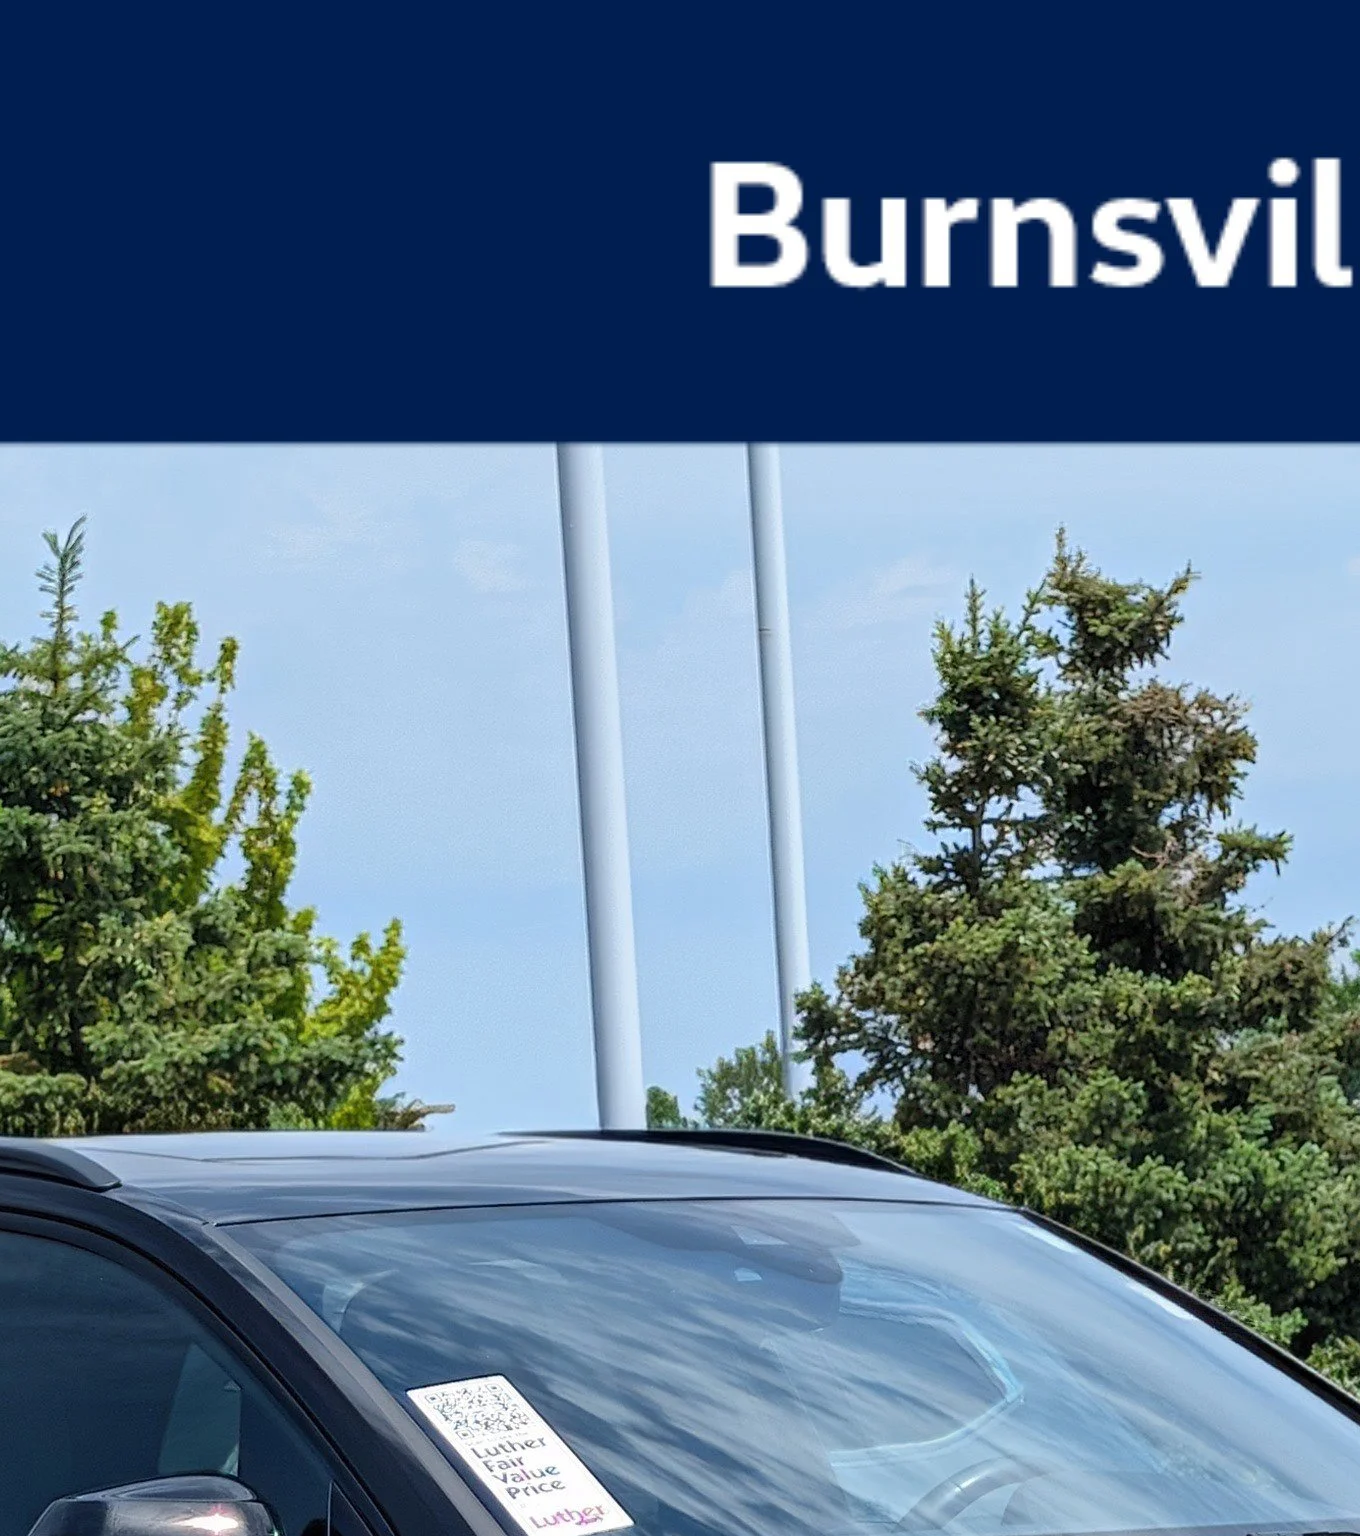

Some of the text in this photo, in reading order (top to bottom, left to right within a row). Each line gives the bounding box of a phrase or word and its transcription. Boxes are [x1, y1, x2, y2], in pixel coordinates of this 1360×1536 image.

[470, 1437, 547, 1459] Luther
[482, 1454, 525, 1472] Fair
[492, 1465, 561, 1484] Value
[505, 1479, 566, 1500] Price
[529, 1504, 606, 1529] Luther
